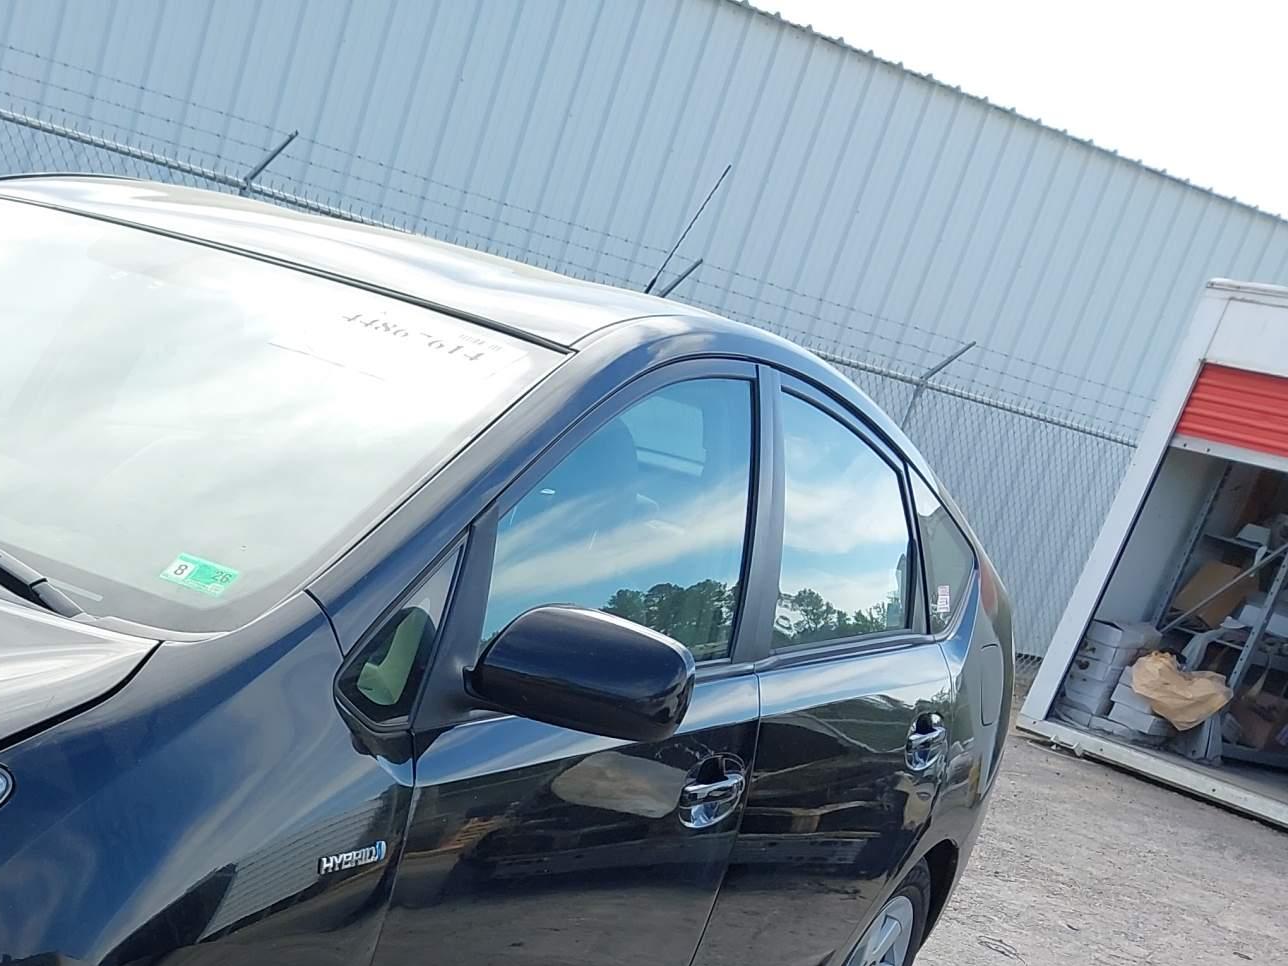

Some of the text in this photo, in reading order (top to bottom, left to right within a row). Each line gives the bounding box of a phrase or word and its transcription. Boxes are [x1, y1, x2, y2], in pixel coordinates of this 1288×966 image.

[173, 564, 233, 585] 8 26
[319, 846, 378, 875] HYBRID
